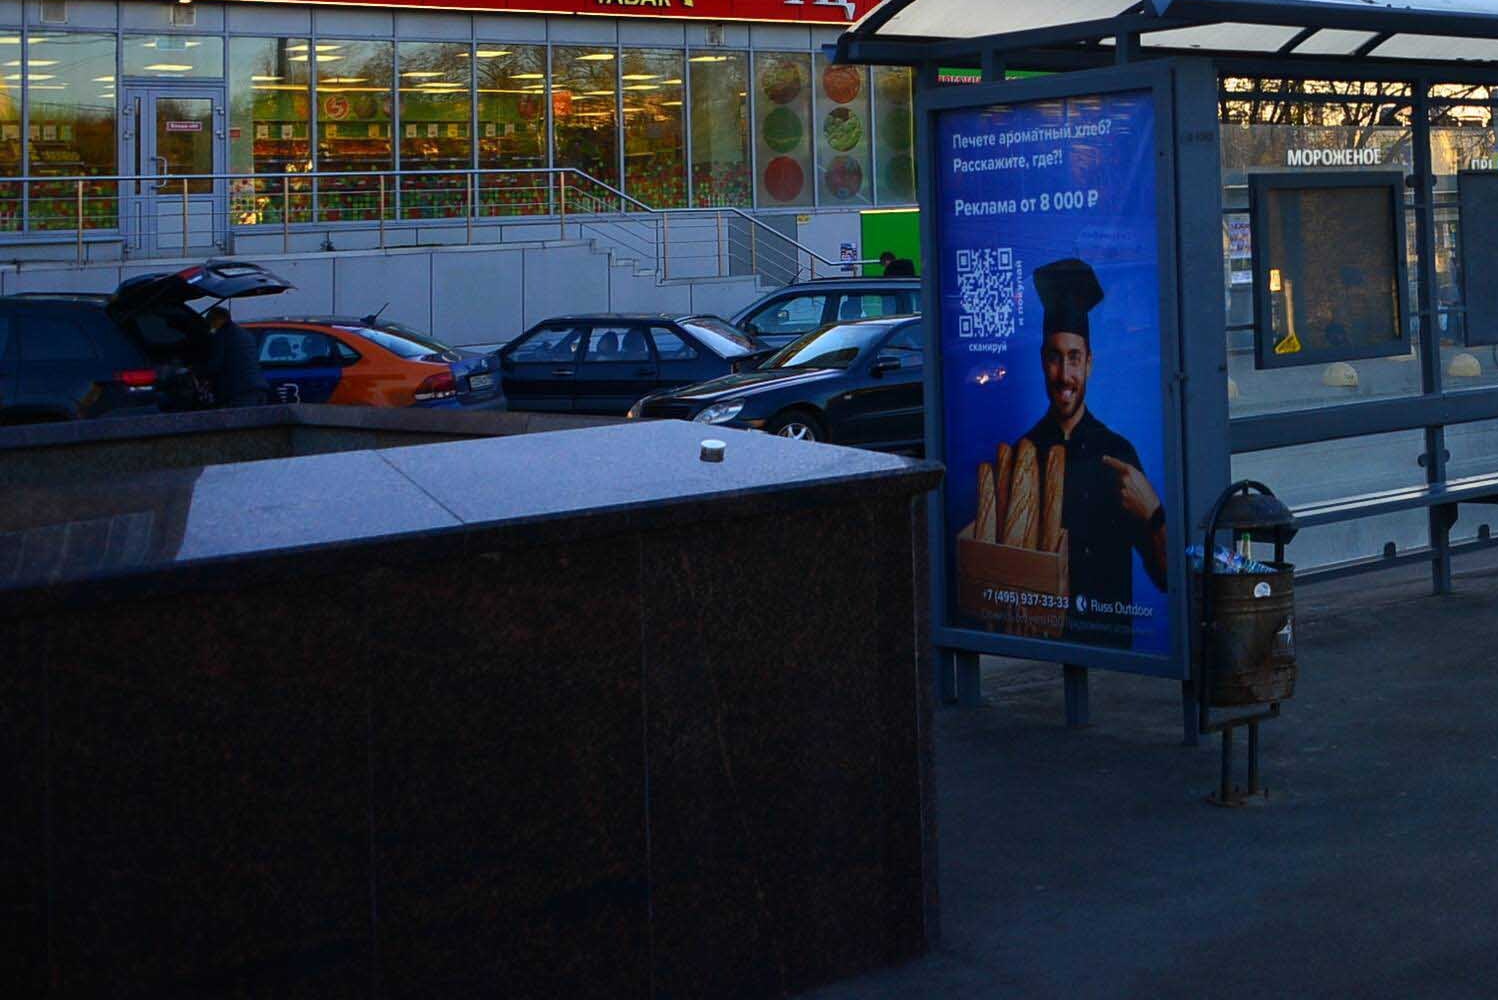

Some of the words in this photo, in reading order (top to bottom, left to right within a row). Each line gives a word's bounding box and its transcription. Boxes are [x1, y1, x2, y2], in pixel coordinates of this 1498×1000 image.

[952, 134, 996, 149] Печете
[999, 123, 1072, 147] ароматный
[1075, 119, 1112, 138] хлеб?
[953, 156, 1030, 173] Расскажите,
[1032, 149, 1063, 168] где?!
[1287, 149, 1382, 166] МОРОЖЕНОЕ
[955, 200, 1016, 216] Реклама
[1020, 199, 1037, 212] от
[1039, 193, 1050, 211] 8
[1054, 191, 1084, 209] 000
[968, 341, 1008, 354] сканируй
[994, 591, 1019, 606] (495)
[1021, 594, 1070, 609] 937-33-33
[1090, 599, 1114, 613] Russ
[1114, 602, 1153, 616] Outdoor
